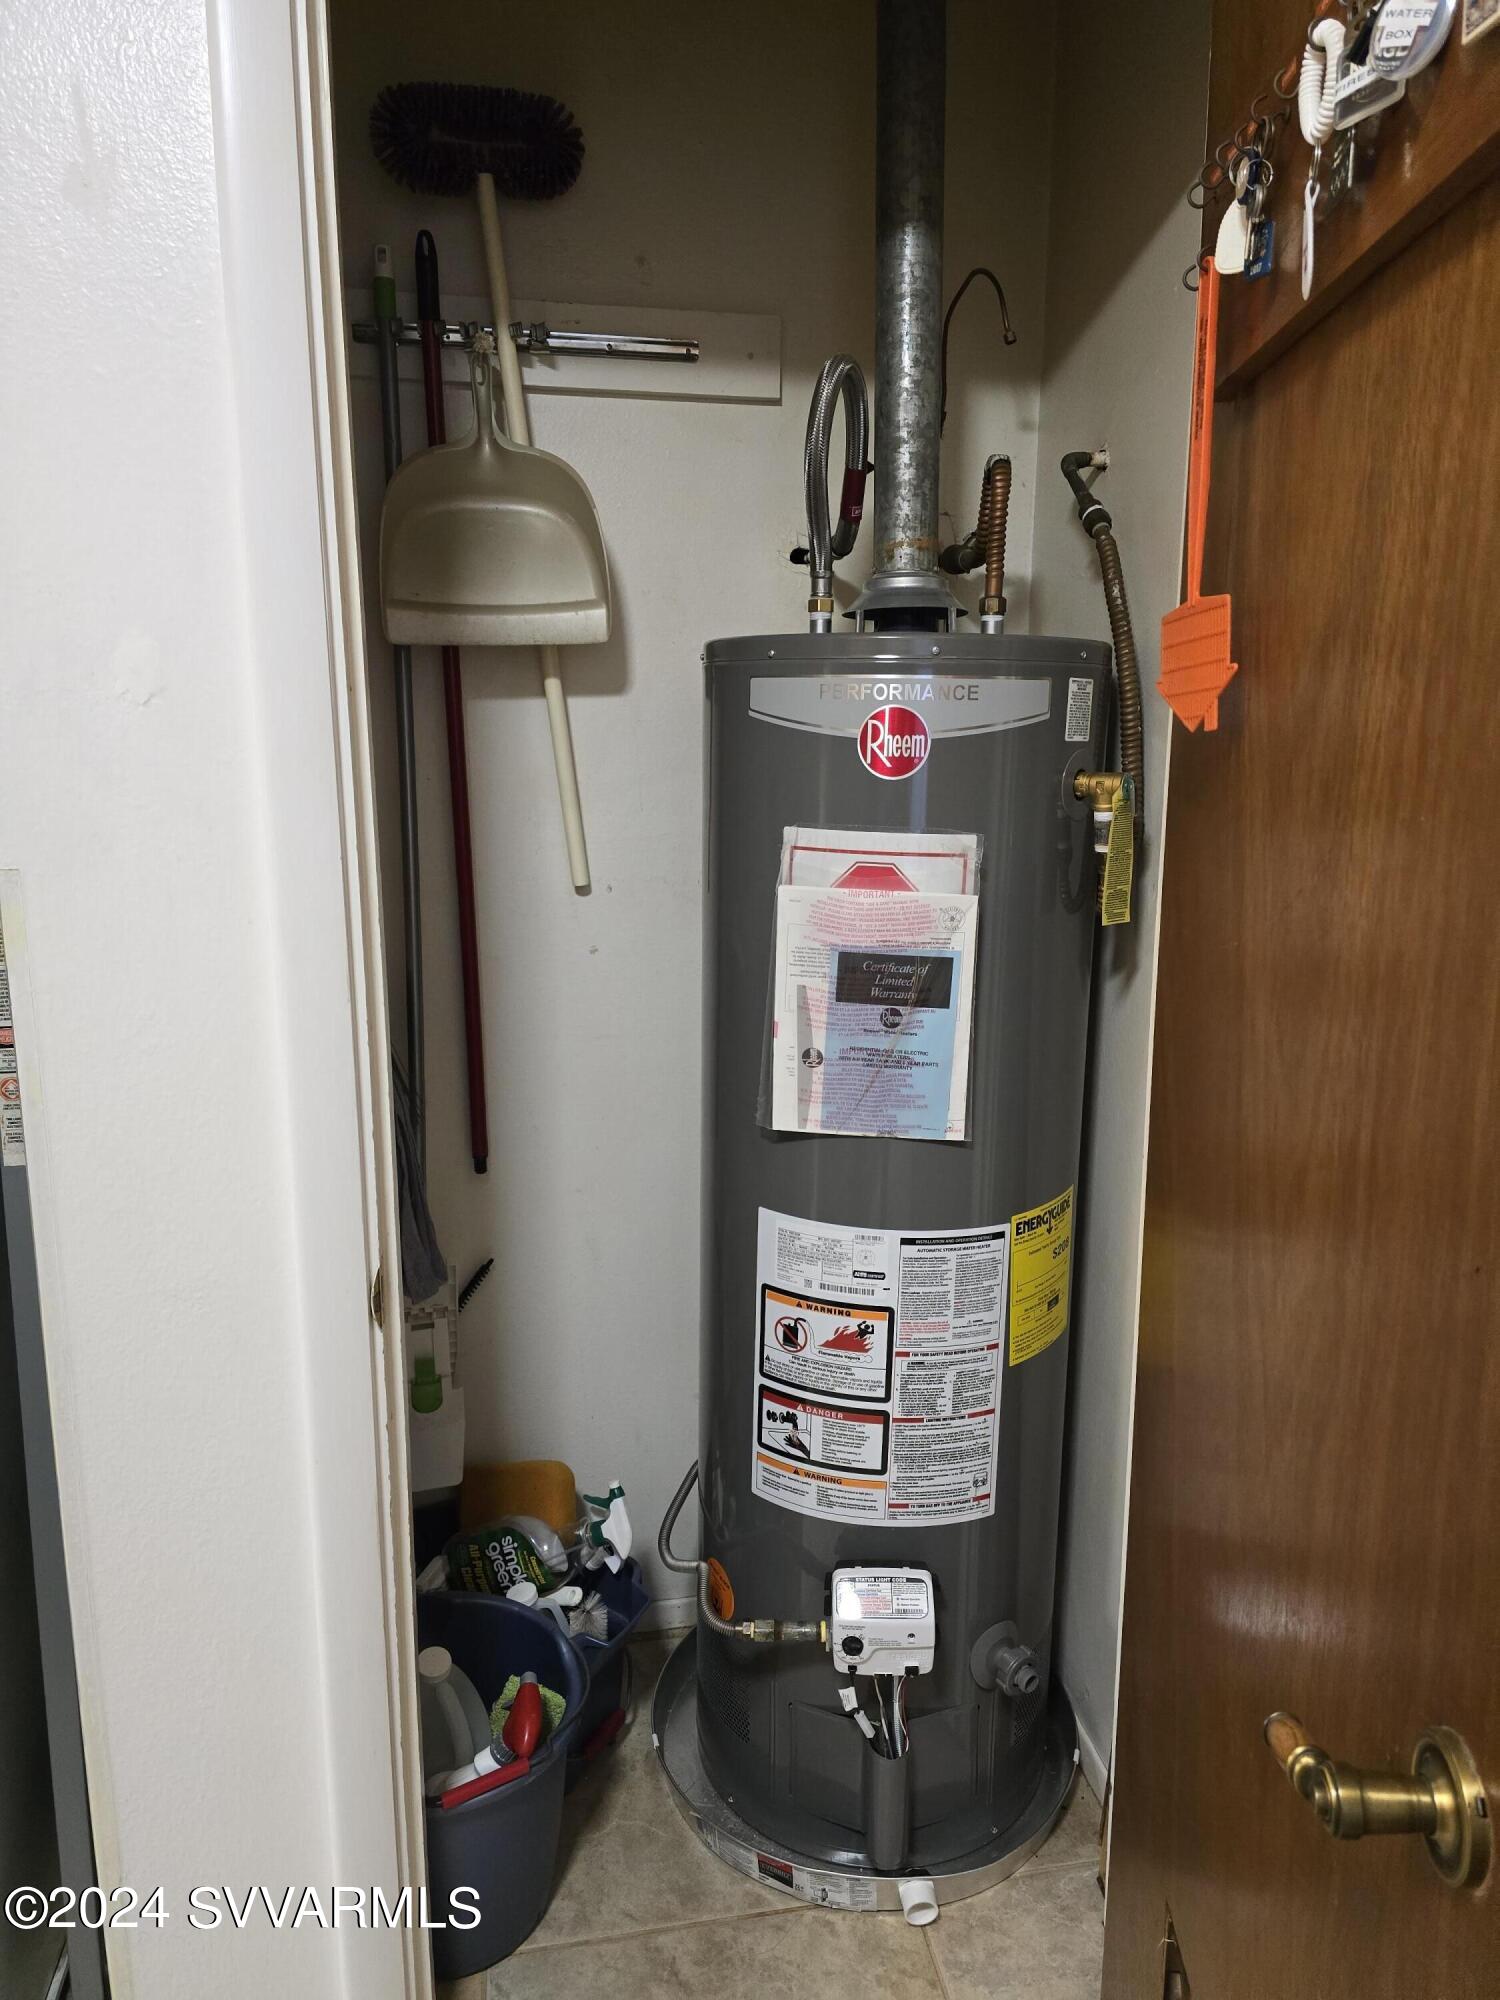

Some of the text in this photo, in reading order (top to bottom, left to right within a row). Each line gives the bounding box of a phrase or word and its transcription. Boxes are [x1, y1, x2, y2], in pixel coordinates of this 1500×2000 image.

[1385, 8, 1433, 19] WATER
[1385, 29, 1412, 40] BOX
[1336, 68, 1377, 95] FIREB
[819, 683, 979, 701] PERFORMANCE
[866, 706, 925, 767] Rheem
[848, 890, 894, 899] IMPORTANT
[863, 960, 931, 977] Certificate of
[874, 974, 913, 987] Limited
[870, 987, 917, 1000] Warranty
[1016, 1196, 1071, 1236] ENERGYGUIDE
[806, 1303, 852, 1317] WARNING
[806, 1407, 844, 1419] DANGER
[804, 1471, 843, 1485] WARNING
